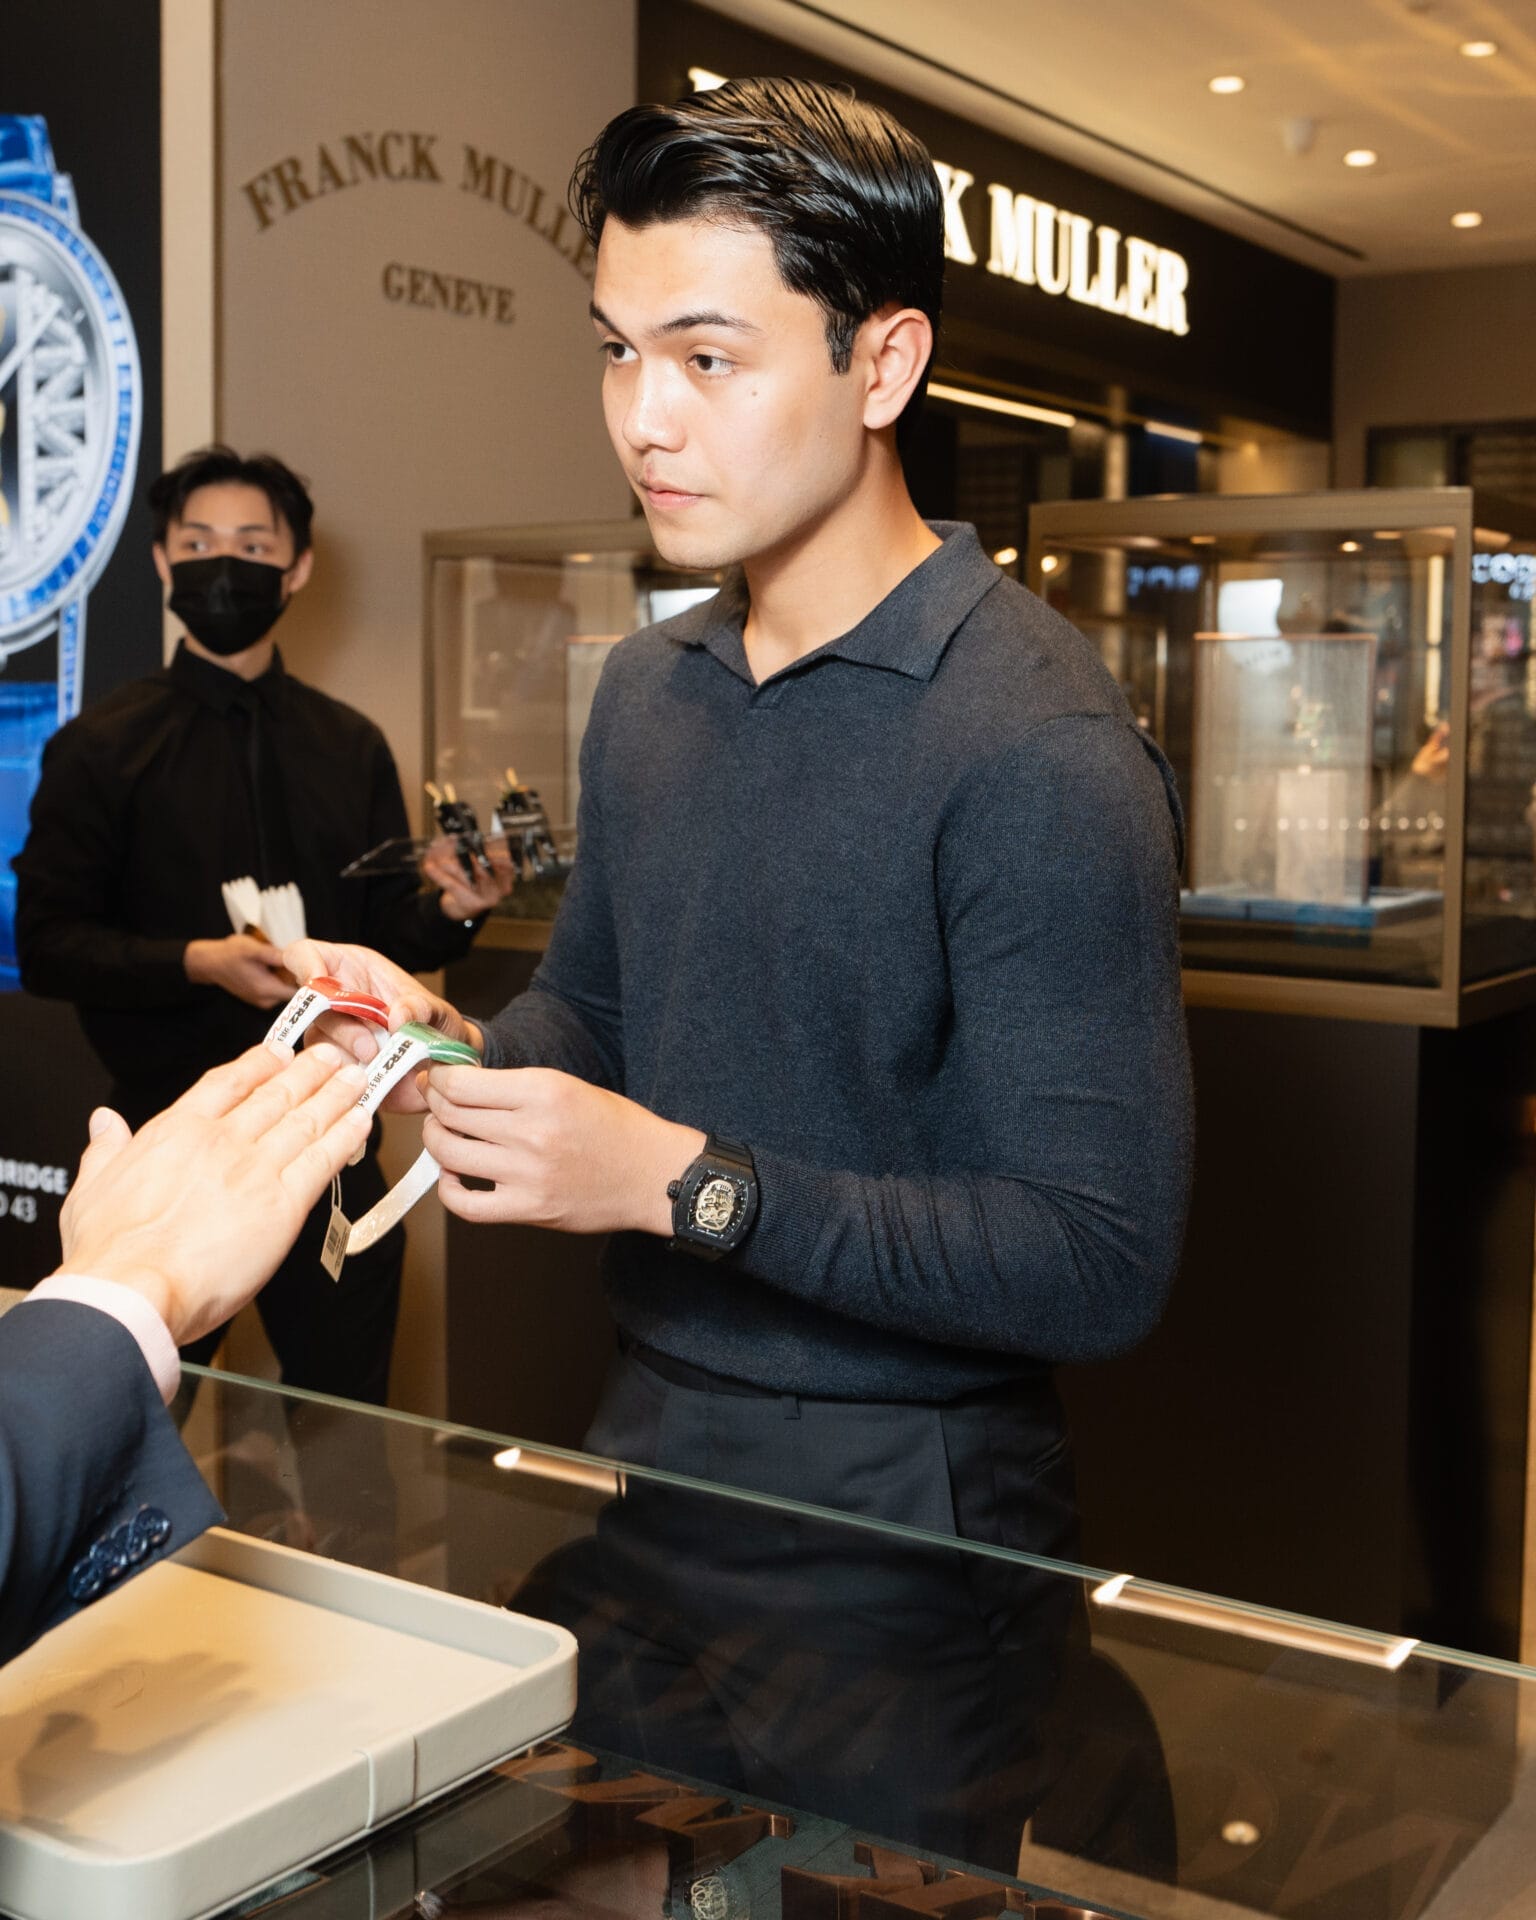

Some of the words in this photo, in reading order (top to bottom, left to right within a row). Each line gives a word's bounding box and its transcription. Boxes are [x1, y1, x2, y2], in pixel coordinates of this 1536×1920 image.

[241, 130, 442, 233] FRANCK
[459, 142, 595, 284] MULLE
[987, 182, 1190, 336] MULLER
[381, 262, 516, 325] GENEVE
